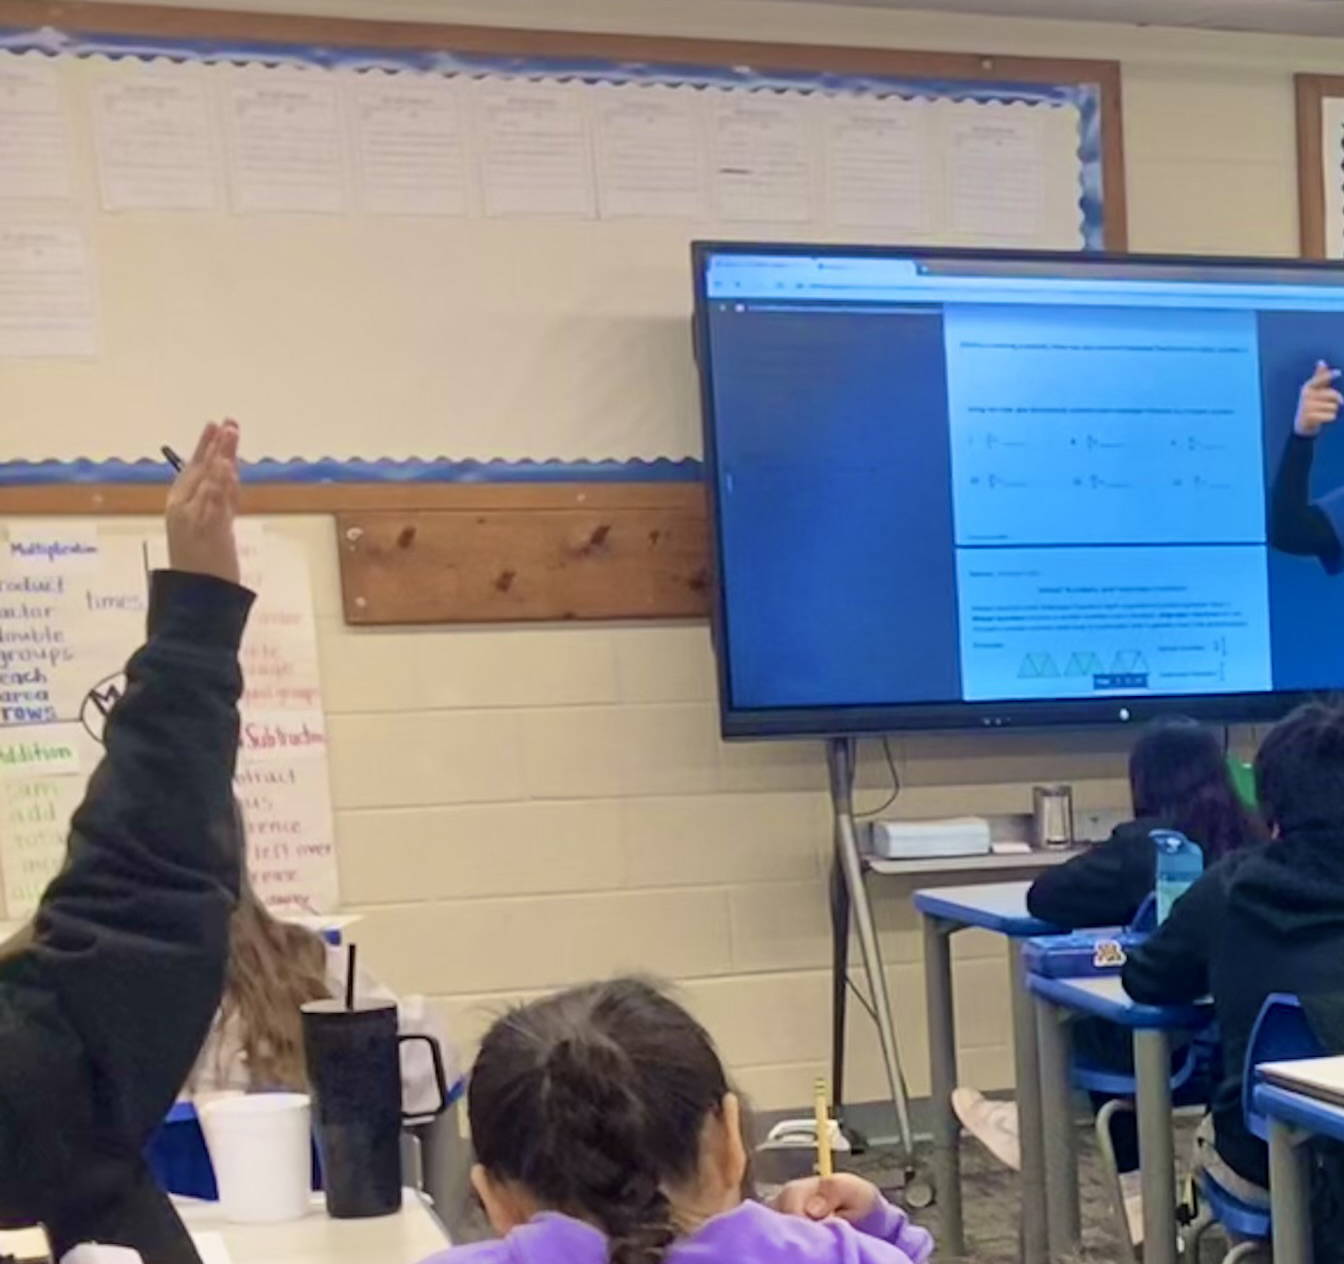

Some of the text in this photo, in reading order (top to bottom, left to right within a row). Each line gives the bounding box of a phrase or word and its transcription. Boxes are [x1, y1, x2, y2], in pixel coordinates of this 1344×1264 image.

[0, 577, 64, 593] roduct
[0, 605, 54, 619] actor
[2, 704, 57, 720] rows
[0, 743, 72, 763] ddition
